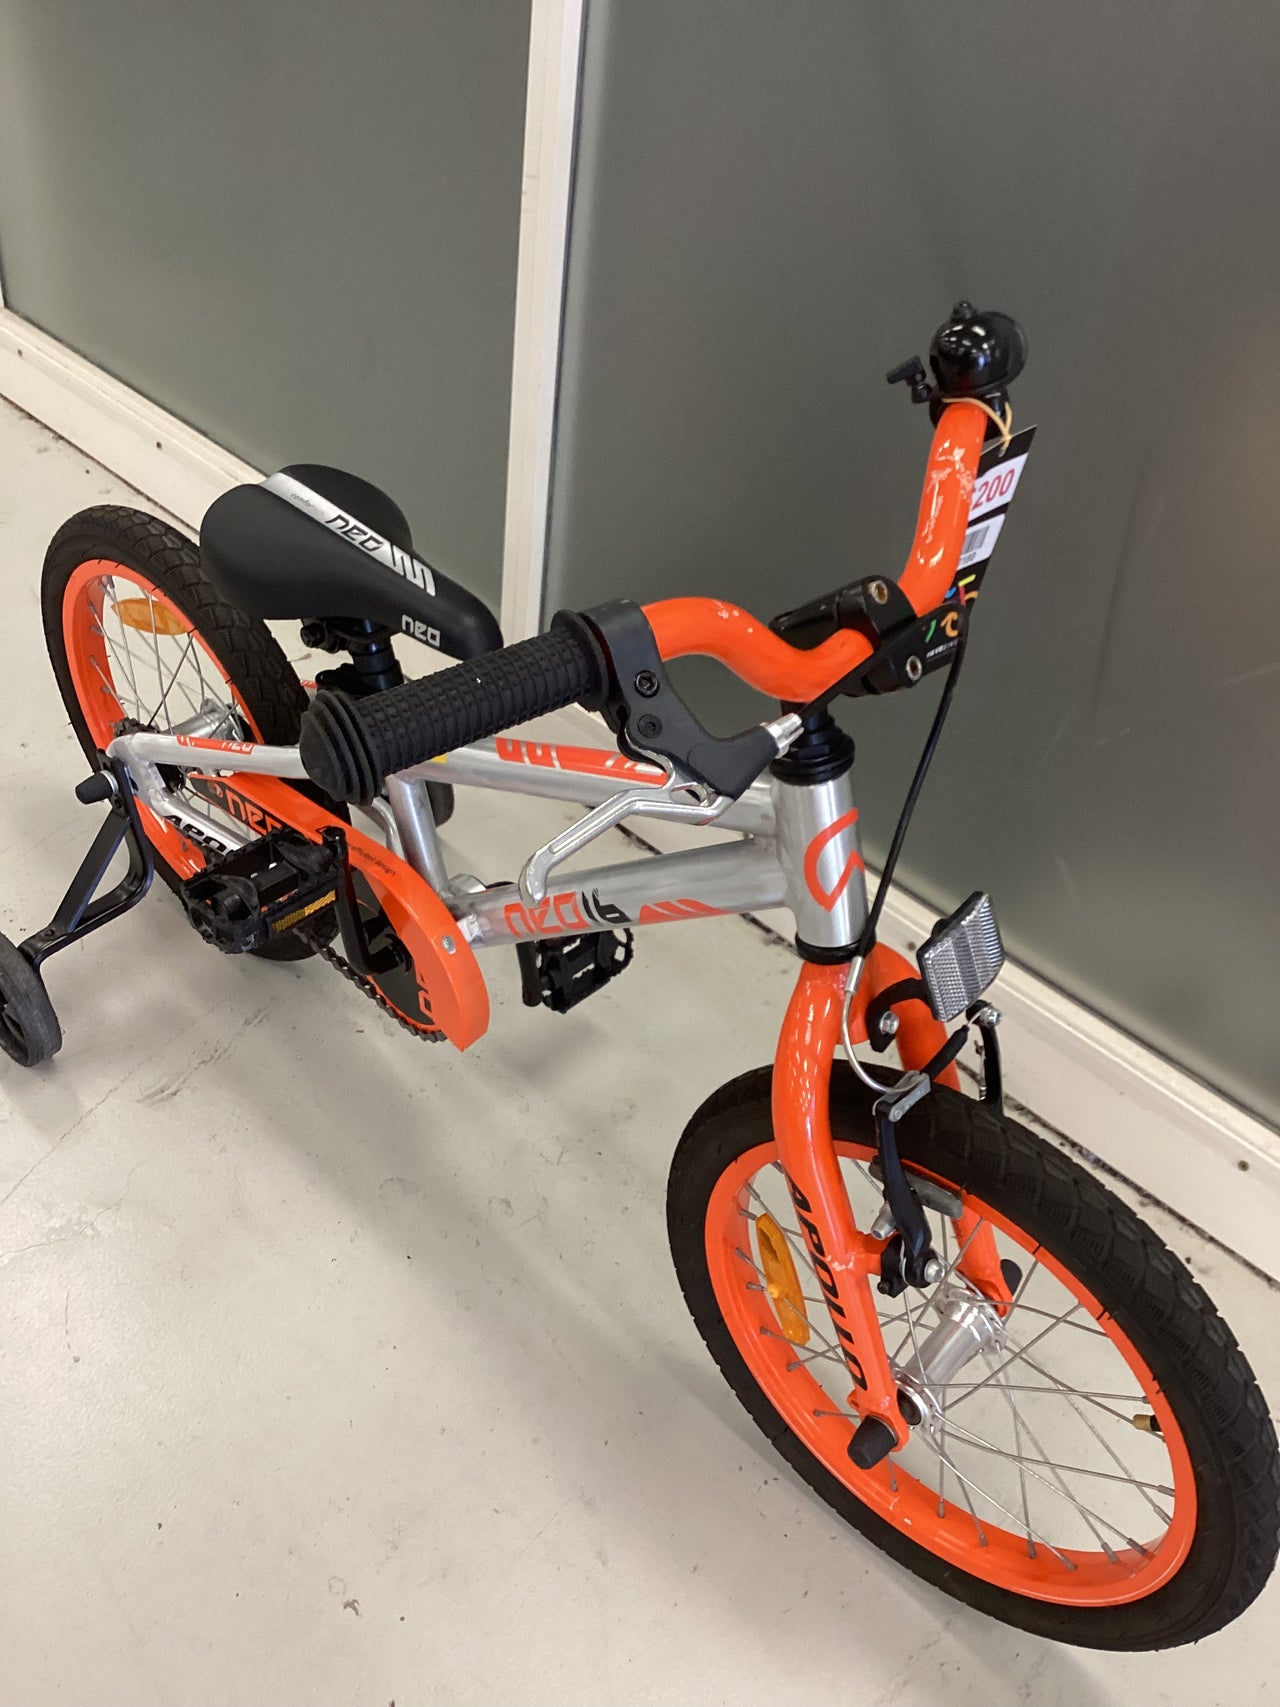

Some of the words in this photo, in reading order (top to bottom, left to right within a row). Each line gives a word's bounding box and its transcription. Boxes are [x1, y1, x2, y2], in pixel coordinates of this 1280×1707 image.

[970, 468, 1016, 511] 200
[325, 513, 384, 552] neo
[401, 614, 441, 648] neo
[784, 1174, 868, 1392] APOLLO
